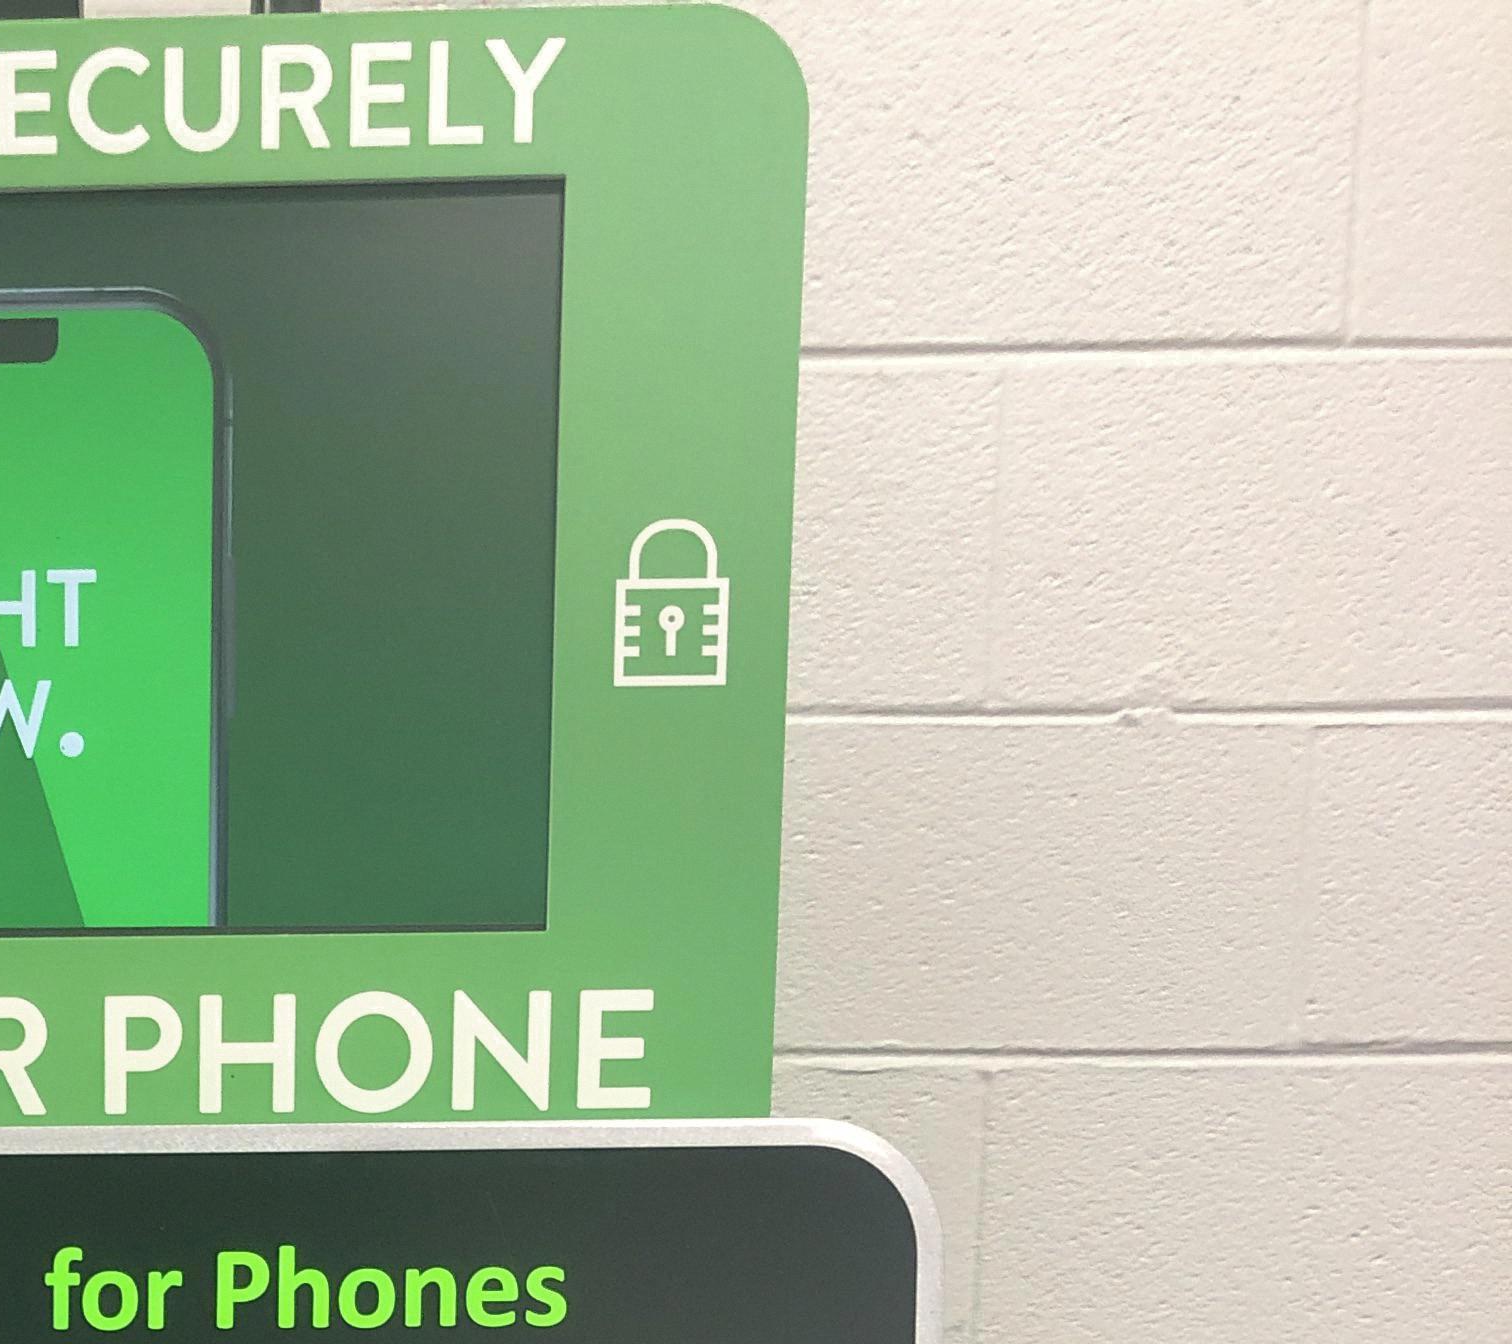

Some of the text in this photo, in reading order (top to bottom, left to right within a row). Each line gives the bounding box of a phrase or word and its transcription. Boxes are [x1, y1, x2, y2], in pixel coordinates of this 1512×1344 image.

[104, 989, 654, 1114] PHONE
[45, 1247, 183, 1332] for
[216, 1245, 568, 1330] Phones
